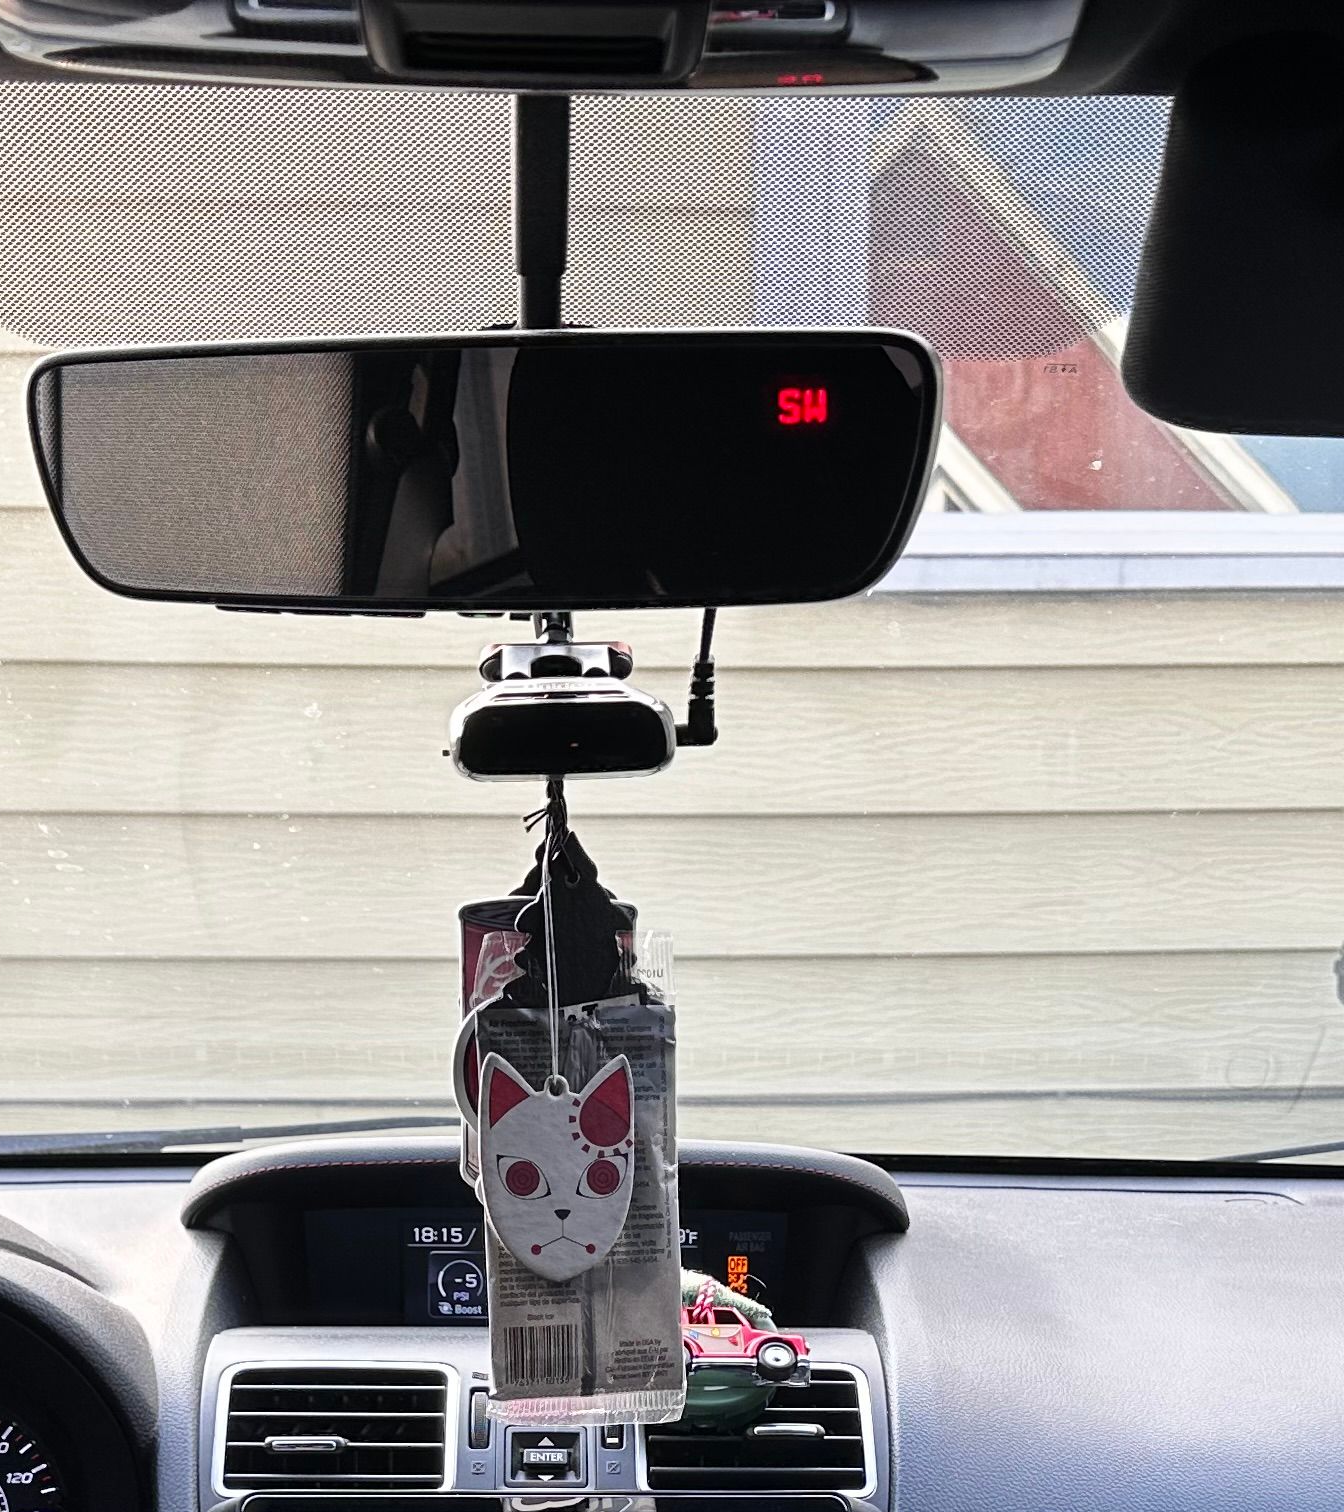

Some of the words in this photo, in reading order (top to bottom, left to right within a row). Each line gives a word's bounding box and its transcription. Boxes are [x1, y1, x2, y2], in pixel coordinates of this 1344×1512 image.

[778, 388, 827, 424] SW
[413, 1227, 463, 1243] 18:15
[729, 1258, 747, 1271] OFF
[453, 1292, 470, 1301] PSI
[455, 1304, 482, 1314] Boost
[529, 1451, 564, 1462] ENTER
[6, 1473, 33, 1485] 120
